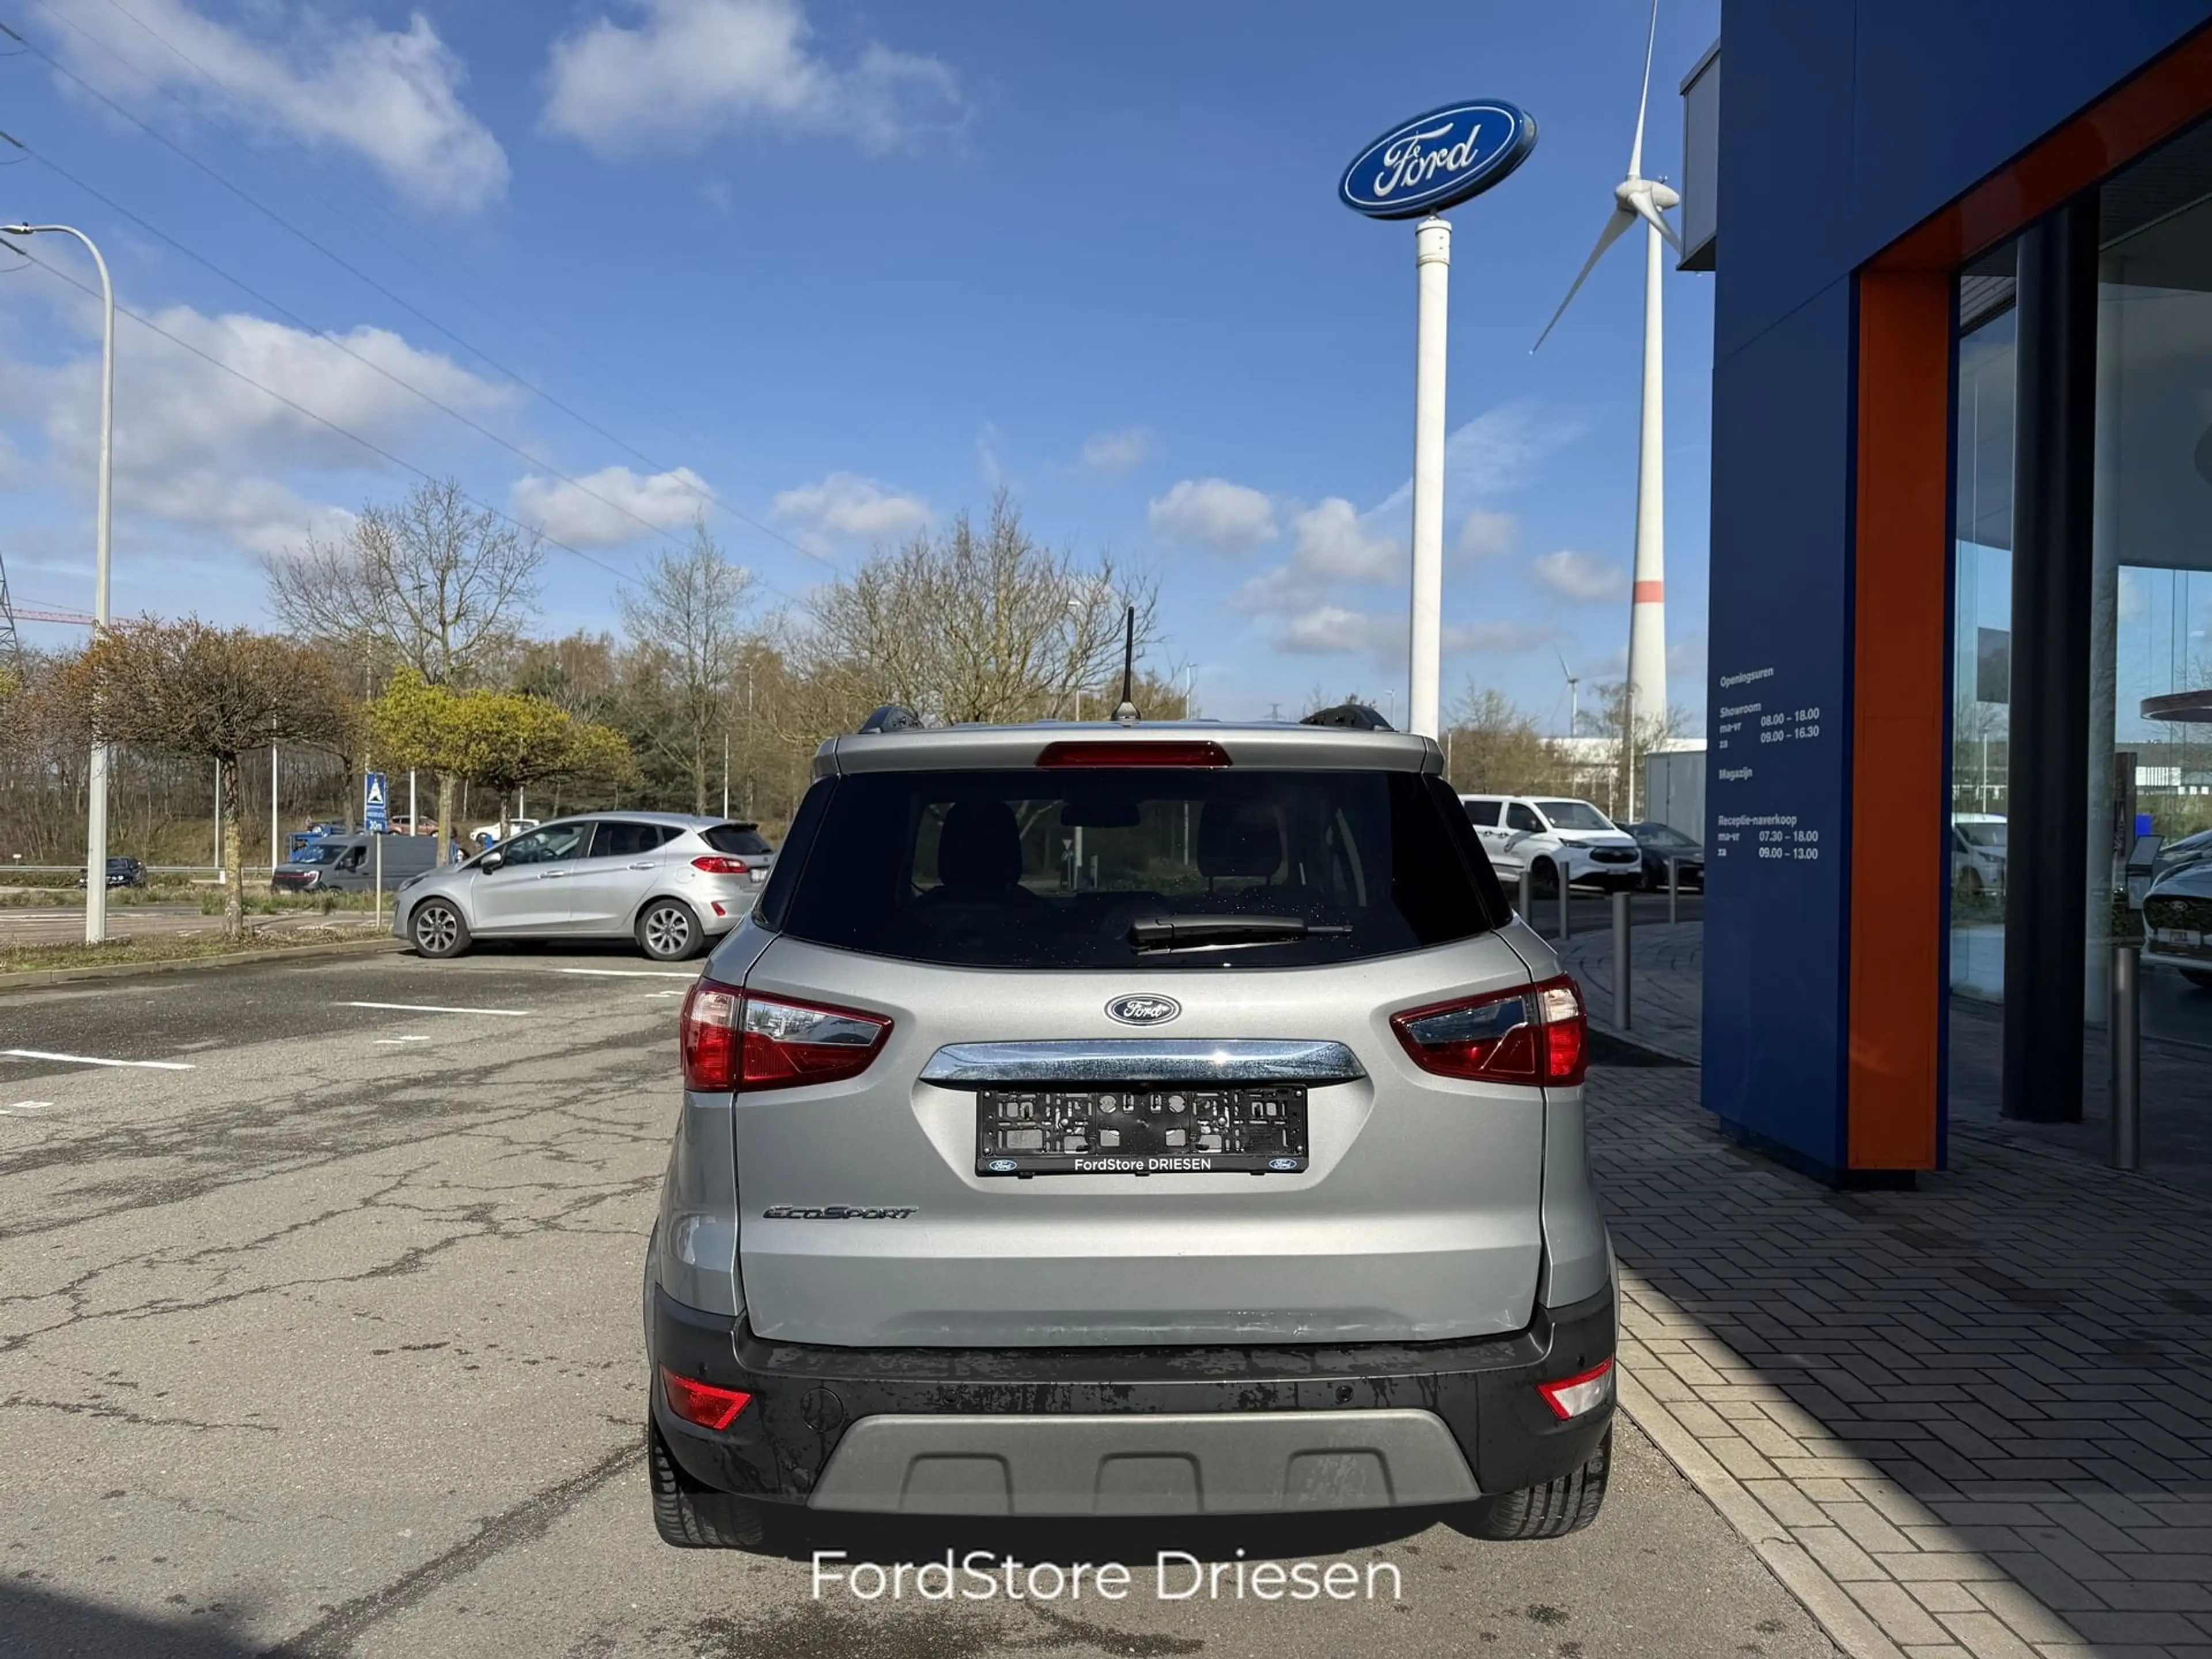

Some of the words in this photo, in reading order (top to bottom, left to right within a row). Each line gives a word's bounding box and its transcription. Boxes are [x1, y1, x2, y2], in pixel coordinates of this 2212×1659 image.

[1373, 122, 1482, 196] Ford
[1719, 667, 1774, 689] Openingsuren
[1719, 703, 1762, 718] Showroom
[1760, 713, 1785, 727] 08.00
[1794, 707, 1820, 722] 18.00
[1760, 730, 1784, 744] 09.00
[1794, 725, 1820, 740] 16.30
[1718, 767, 1753, 781] Magazijn
[1759, 831, 1783, 842] 07.30
[1793, 830, 1819, 842] 18.00
[1759, 847, 1783, 858] 09.00
[1793, 847, 1819, 859] 13.00
[1124, 1001, 1162, 1017] Ford
[1074, 1158, 1144, 1171] FordStore
[1148, 1158, 1211, 1170] DRIESEN
